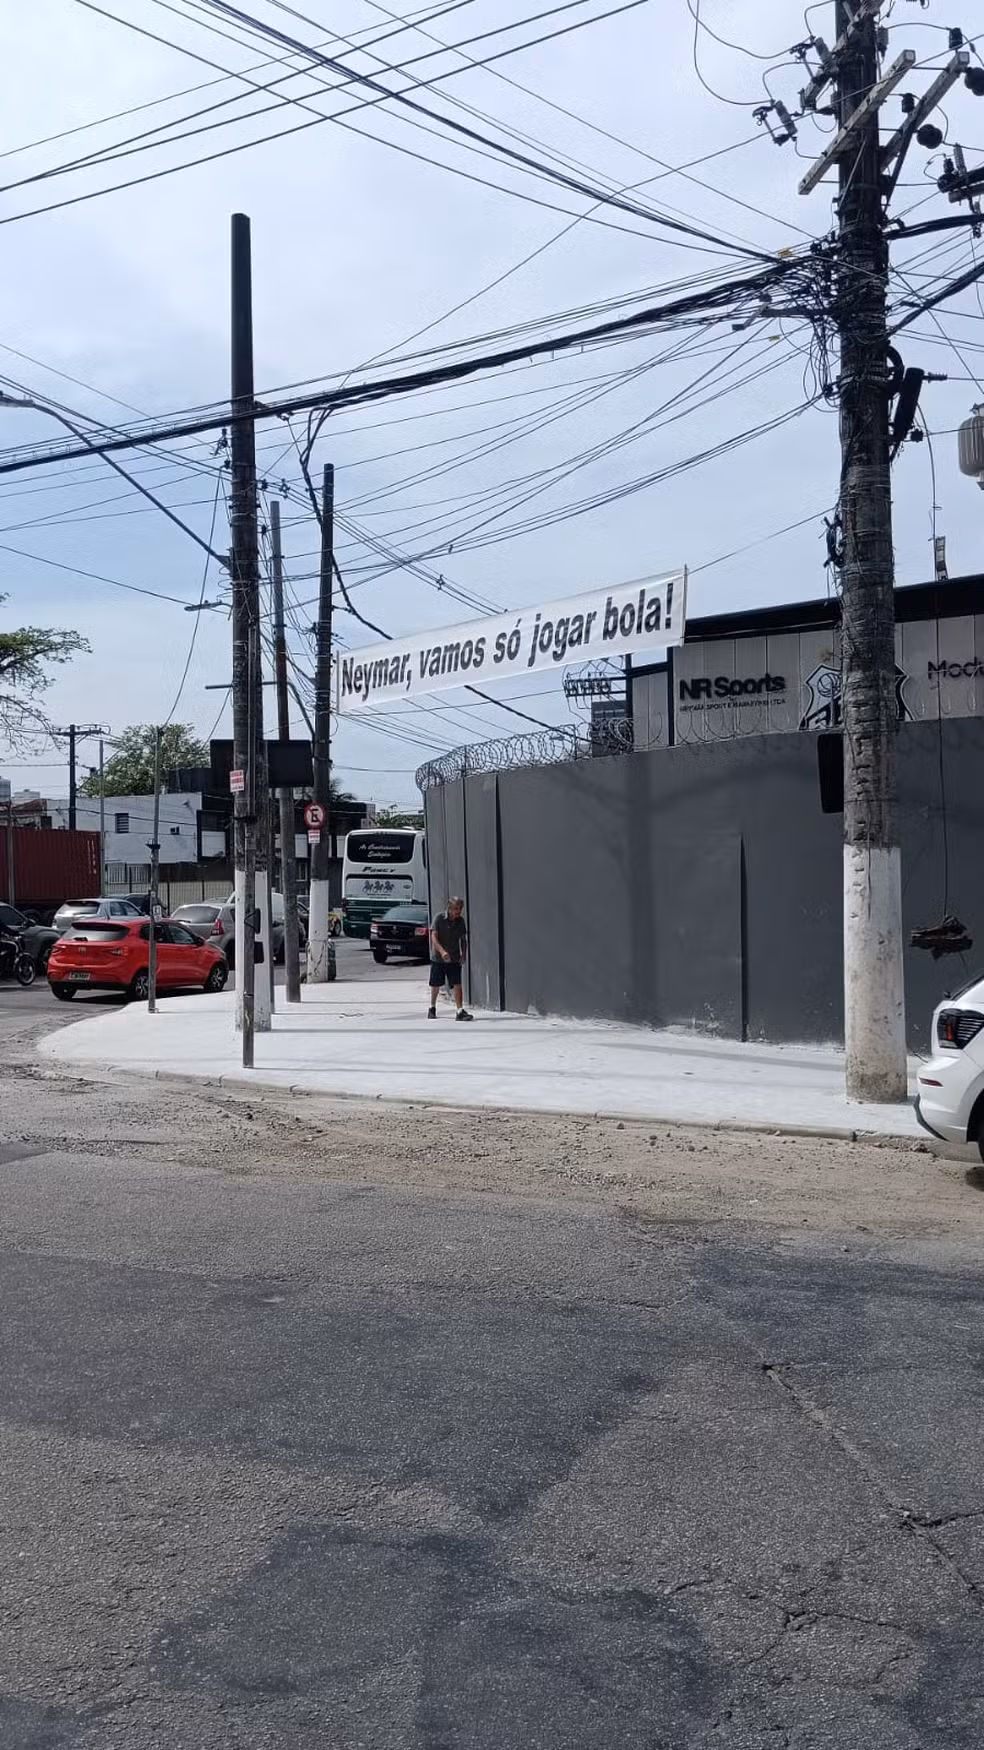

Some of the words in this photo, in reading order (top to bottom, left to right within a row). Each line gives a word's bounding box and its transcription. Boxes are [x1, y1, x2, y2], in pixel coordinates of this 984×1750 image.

[341, 653, 412, 702] Neymar,
[420, 637, 486, 679] vamos
[493, 618, 522, 664] só
[527, 611, 597, 668] jogar
[603, 582, 674, 641] bola!
